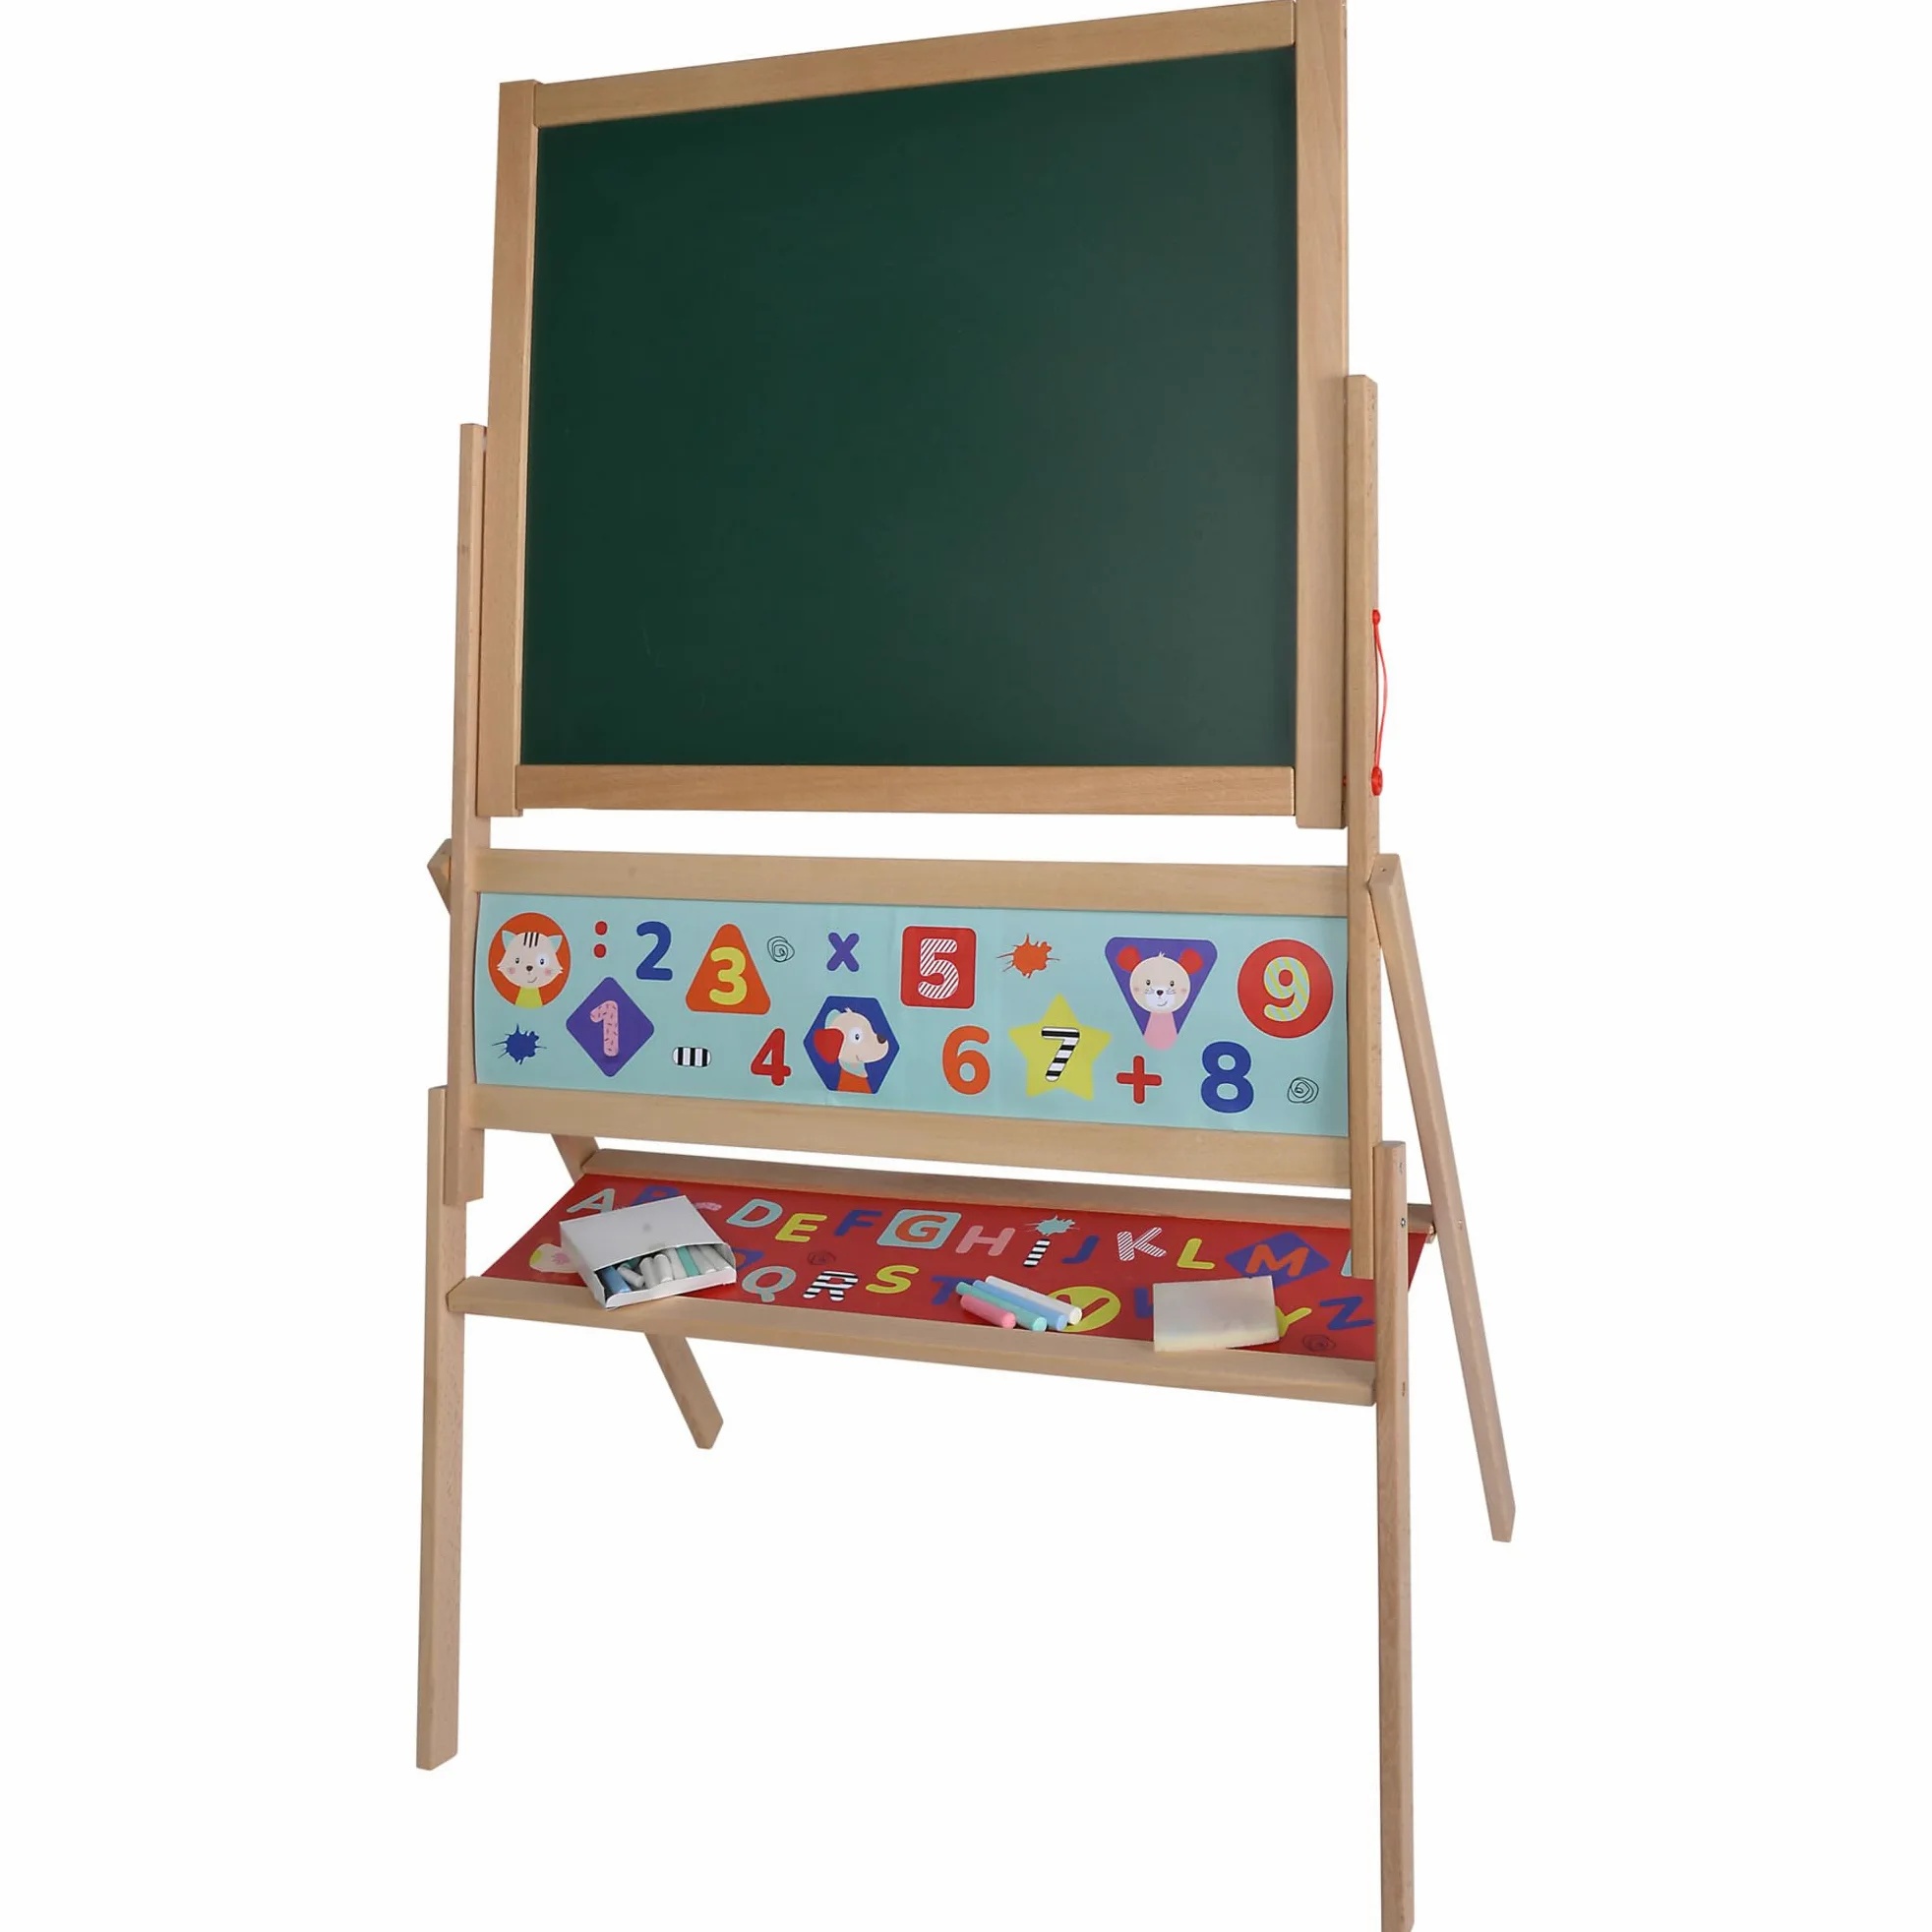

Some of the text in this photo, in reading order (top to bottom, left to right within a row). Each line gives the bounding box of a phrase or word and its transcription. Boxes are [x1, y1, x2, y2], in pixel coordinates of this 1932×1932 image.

[635, 921, 673, 981] 2
[708, 946, 748, 1005] 3
[918, 937, 959, 1000] 5
[1263, 956, 1311, 1023] 9
[590, 999, 620, 1057] 1
[751, 1027, 791, 1086] 4
[941, 1025, 992, 1096] 6
[1041, 1026, 1080, 1083] 7
[1200, 1041, 1255, 1114] 8
[566, 1187, 616, 1214] A
[726, 1198, 783, 1229] D
[775, 1213, 827, 1242] E
[834, 1209, 883, 1237] F
[894, 1215, 947, 1242] G
[955, 1226, 1016, 1256] H
[1061, 1236, 1101, 1264] J
[1117, 1227, 1168, 1261] K
[1177, 1238, 1216, 1270] L
[1245, 1244, 1309, 1276] M
[741, 1265, 797, 1303] Q
[803, 1270, 860, 1301] R
[866, 1264, 920, 1295] S
[931, 1276, 980, 1305] T
[1319, 1296, 1374, 1330] Z
